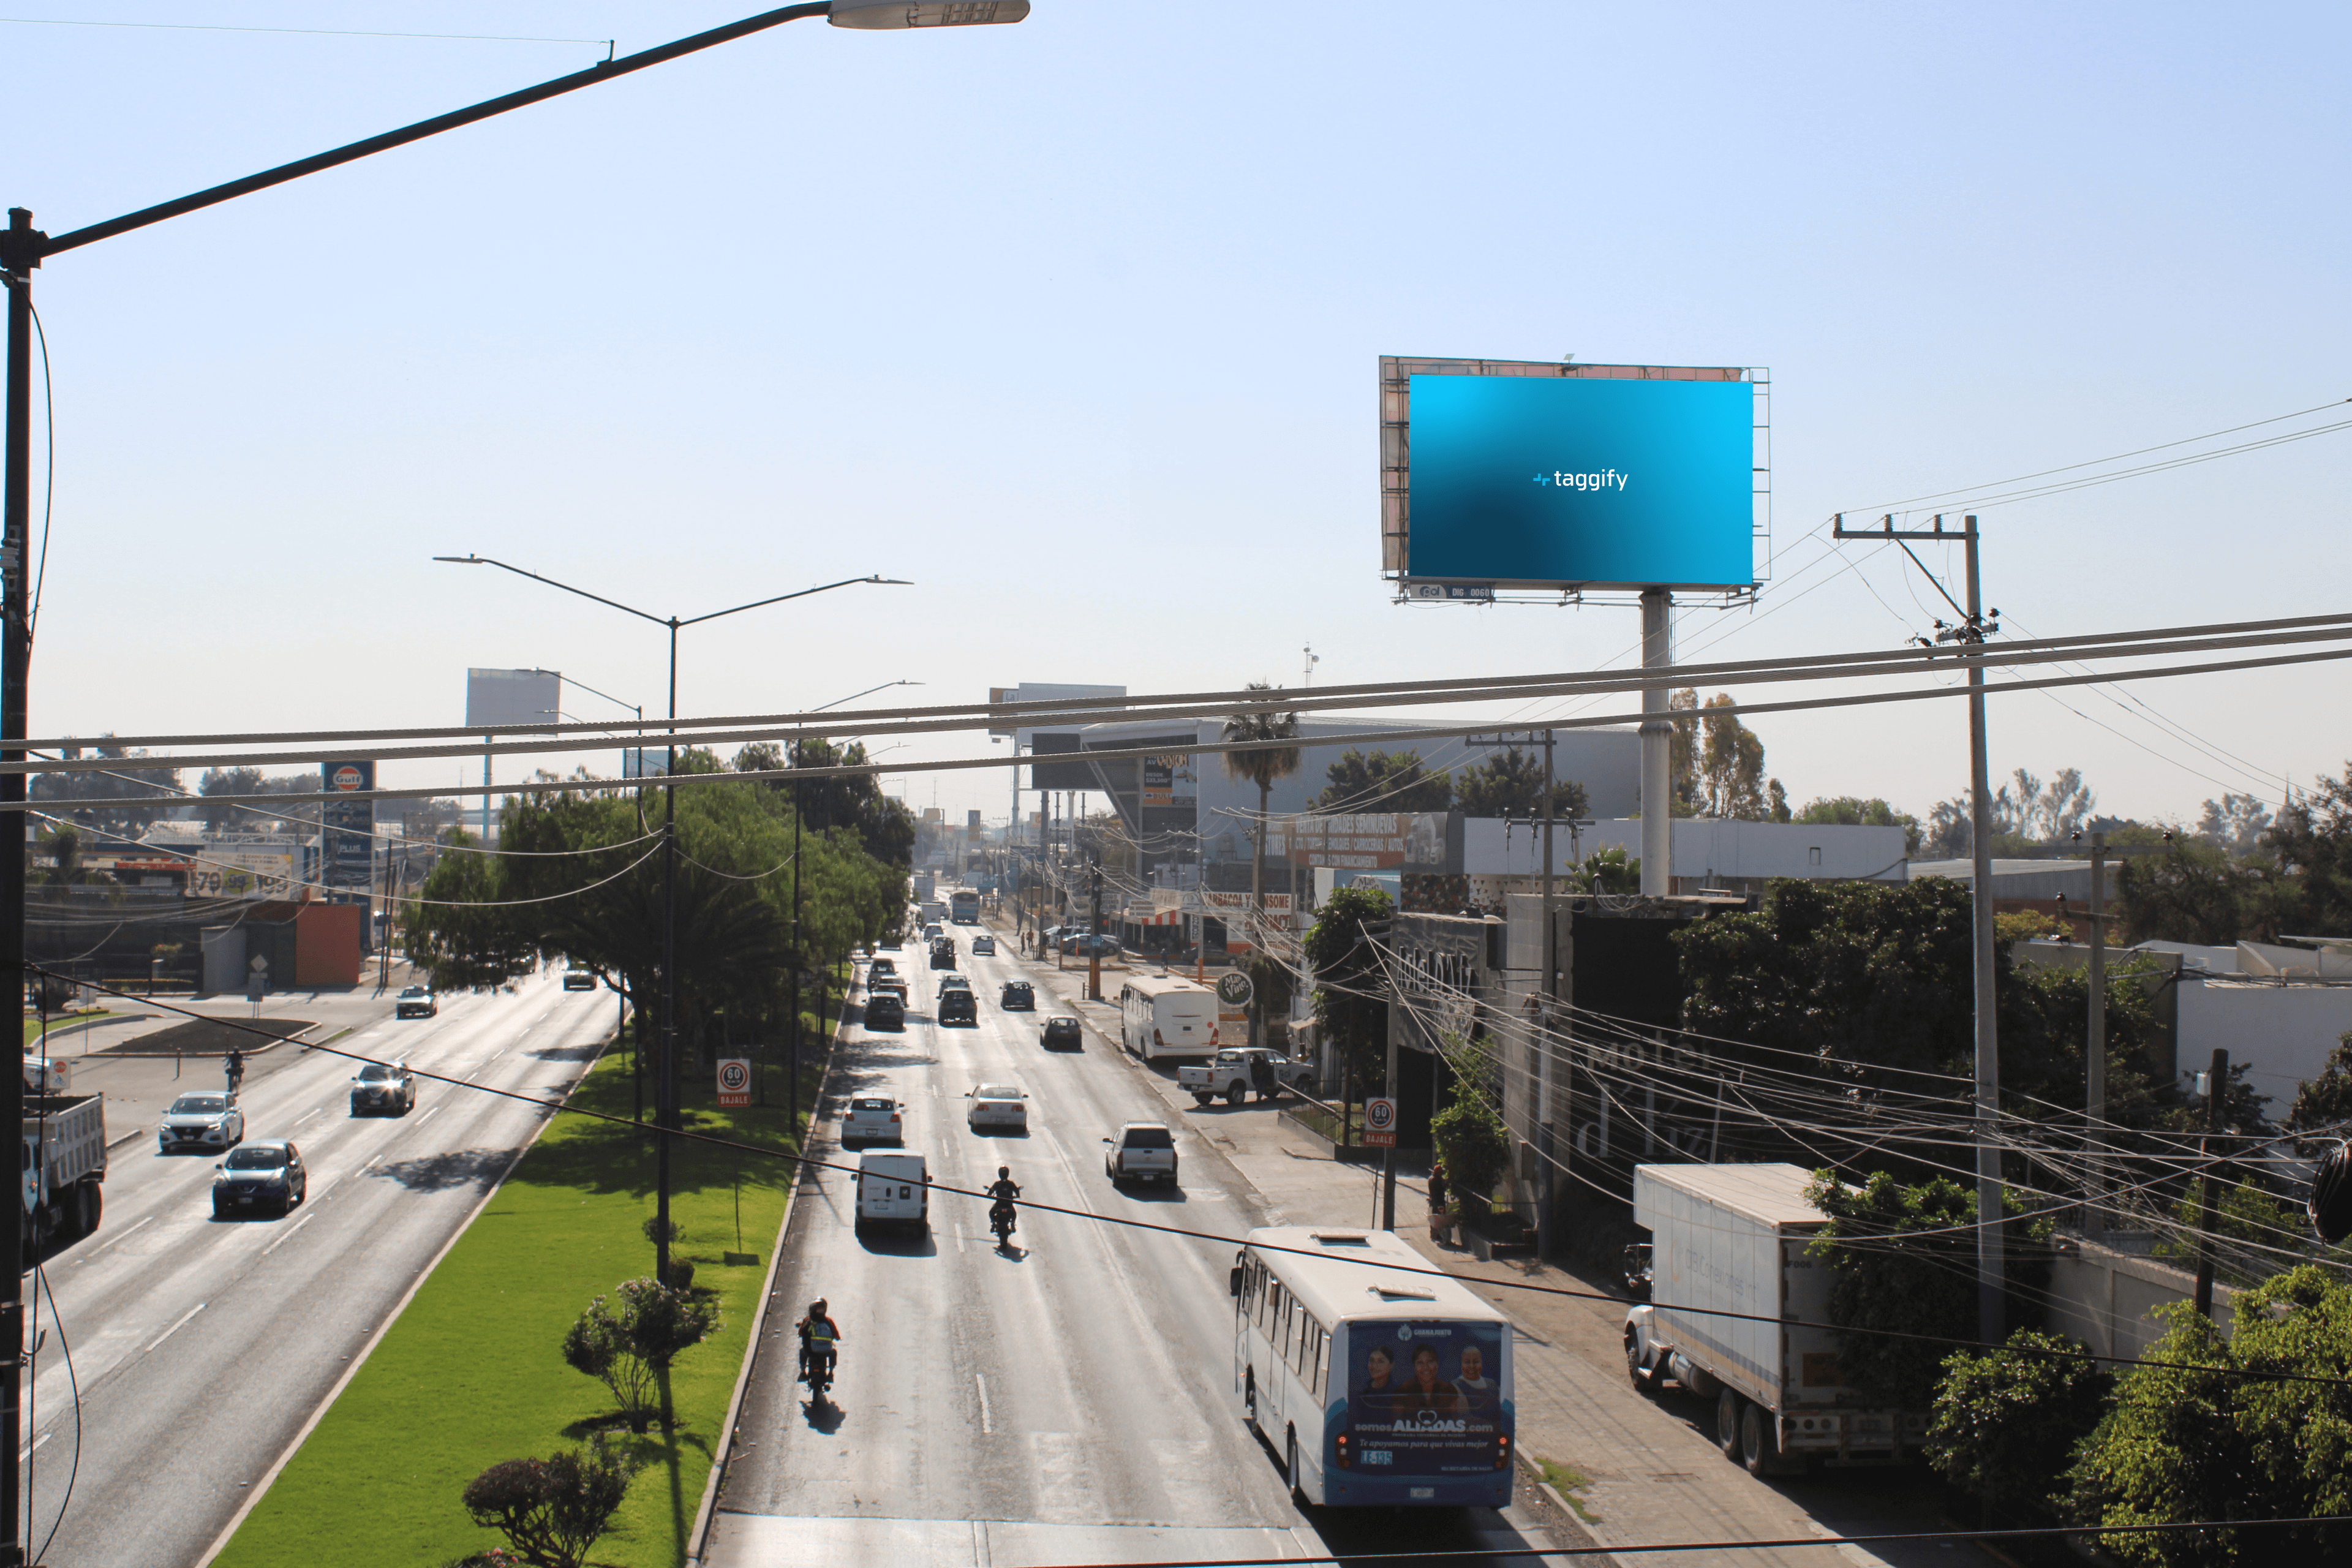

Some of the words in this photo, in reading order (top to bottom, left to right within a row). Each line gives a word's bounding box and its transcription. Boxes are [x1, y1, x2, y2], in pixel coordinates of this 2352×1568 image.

[1554, 469, 1628, 491] taggify
[335, 775, 360, 783] Gulf
[1355, 815, 1397, 834] SEMINUEVAS
[338, 844, 361, 853] PLUS
[1388, 837, 1404, 852] AUTOS
[1245, 894, 1251, 908] Y
[1263, 894, 1289, 908] NSOME
[727, 1068, 741, 1079] 60
[720, 1096, 748, 1104] BAJALE
[1375, 1106, 1387, 1117] 60
[1366, 1134, 1393, 1145] BAJALE
[1359, 1438, 1368, 1447] Te
[1369, 1440, 1409, 1449] apoyamos
[1410, 1441, 1428, 1449] para
[1430, 1441, 1443, 1450] que
[1466, 1439, 1488, 1449] mejor
